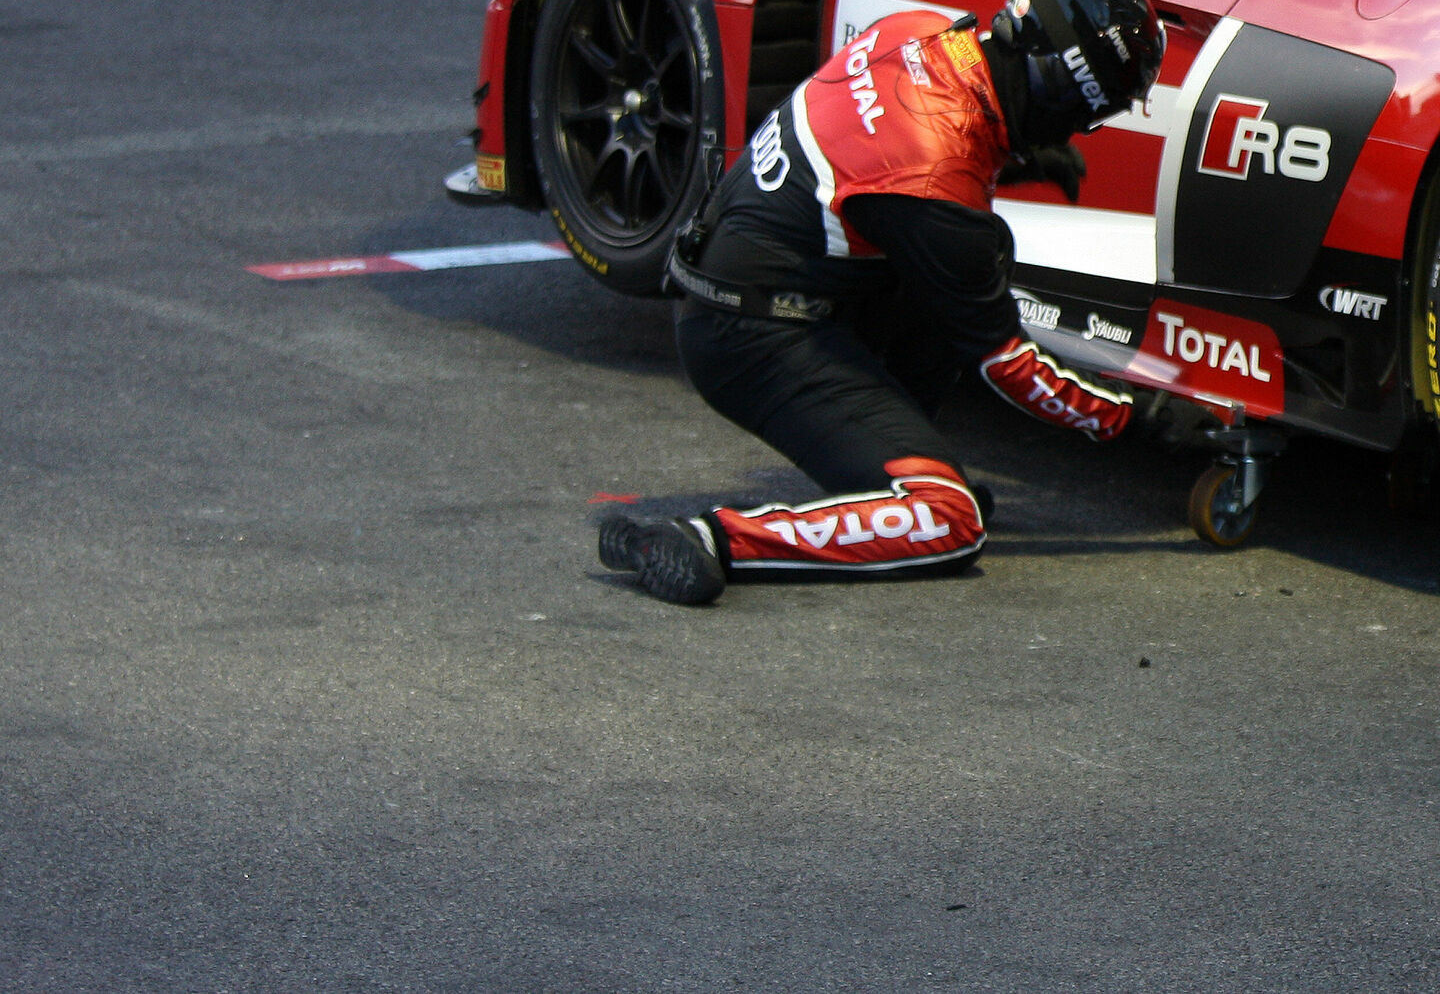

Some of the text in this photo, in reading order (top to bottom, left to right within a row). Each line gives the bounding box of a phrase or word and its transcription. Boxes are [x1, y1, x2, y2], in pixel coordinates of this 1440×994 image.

[1107, 24, 1131, 63] uvex
[845, 29, 885, 135] TOTAL
[1062, 45, 1110, 112] uvex
[1227, 117, 1332, 182] R8
[1017, 299, 1062, 327] MAYER
[1081, 311, 1133, 345] STÄUBLI
[1331, 287, 1388, 321] WRT
[1156, 311, 1272, 383] TOTAL
[1027, 374, 1113, 437] TOTA
[764, 501, 950, 549] TOTAL
